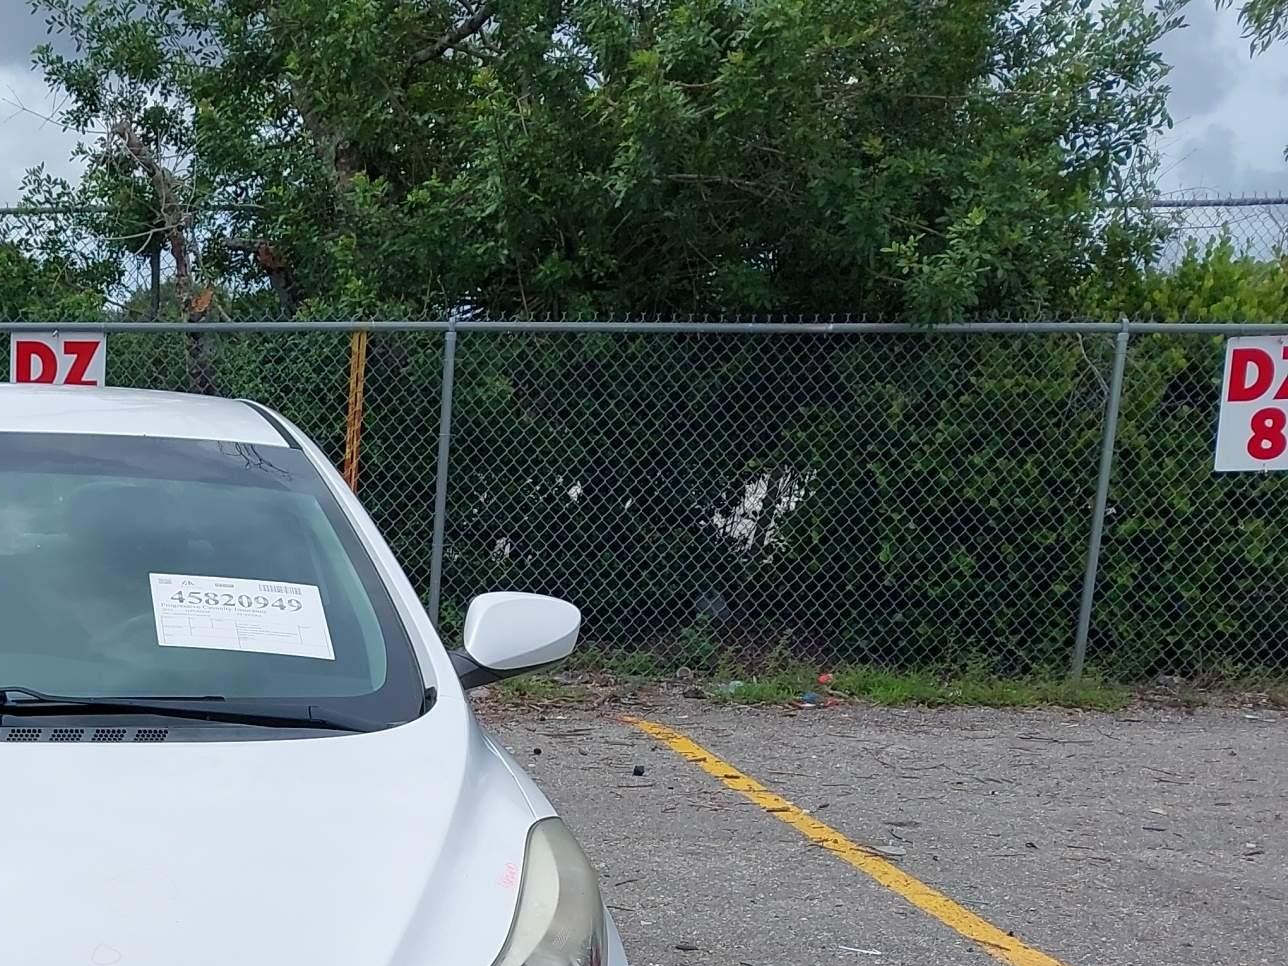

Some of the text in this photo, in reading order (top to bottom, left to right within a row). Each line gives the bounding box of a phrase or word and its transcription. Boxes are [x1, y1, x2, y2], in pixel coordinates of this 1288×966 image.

[16, 340, 101, 386] DZ
[1247, 407, 1287, 460] 8
[170, 590, 303, 613] 45820949
